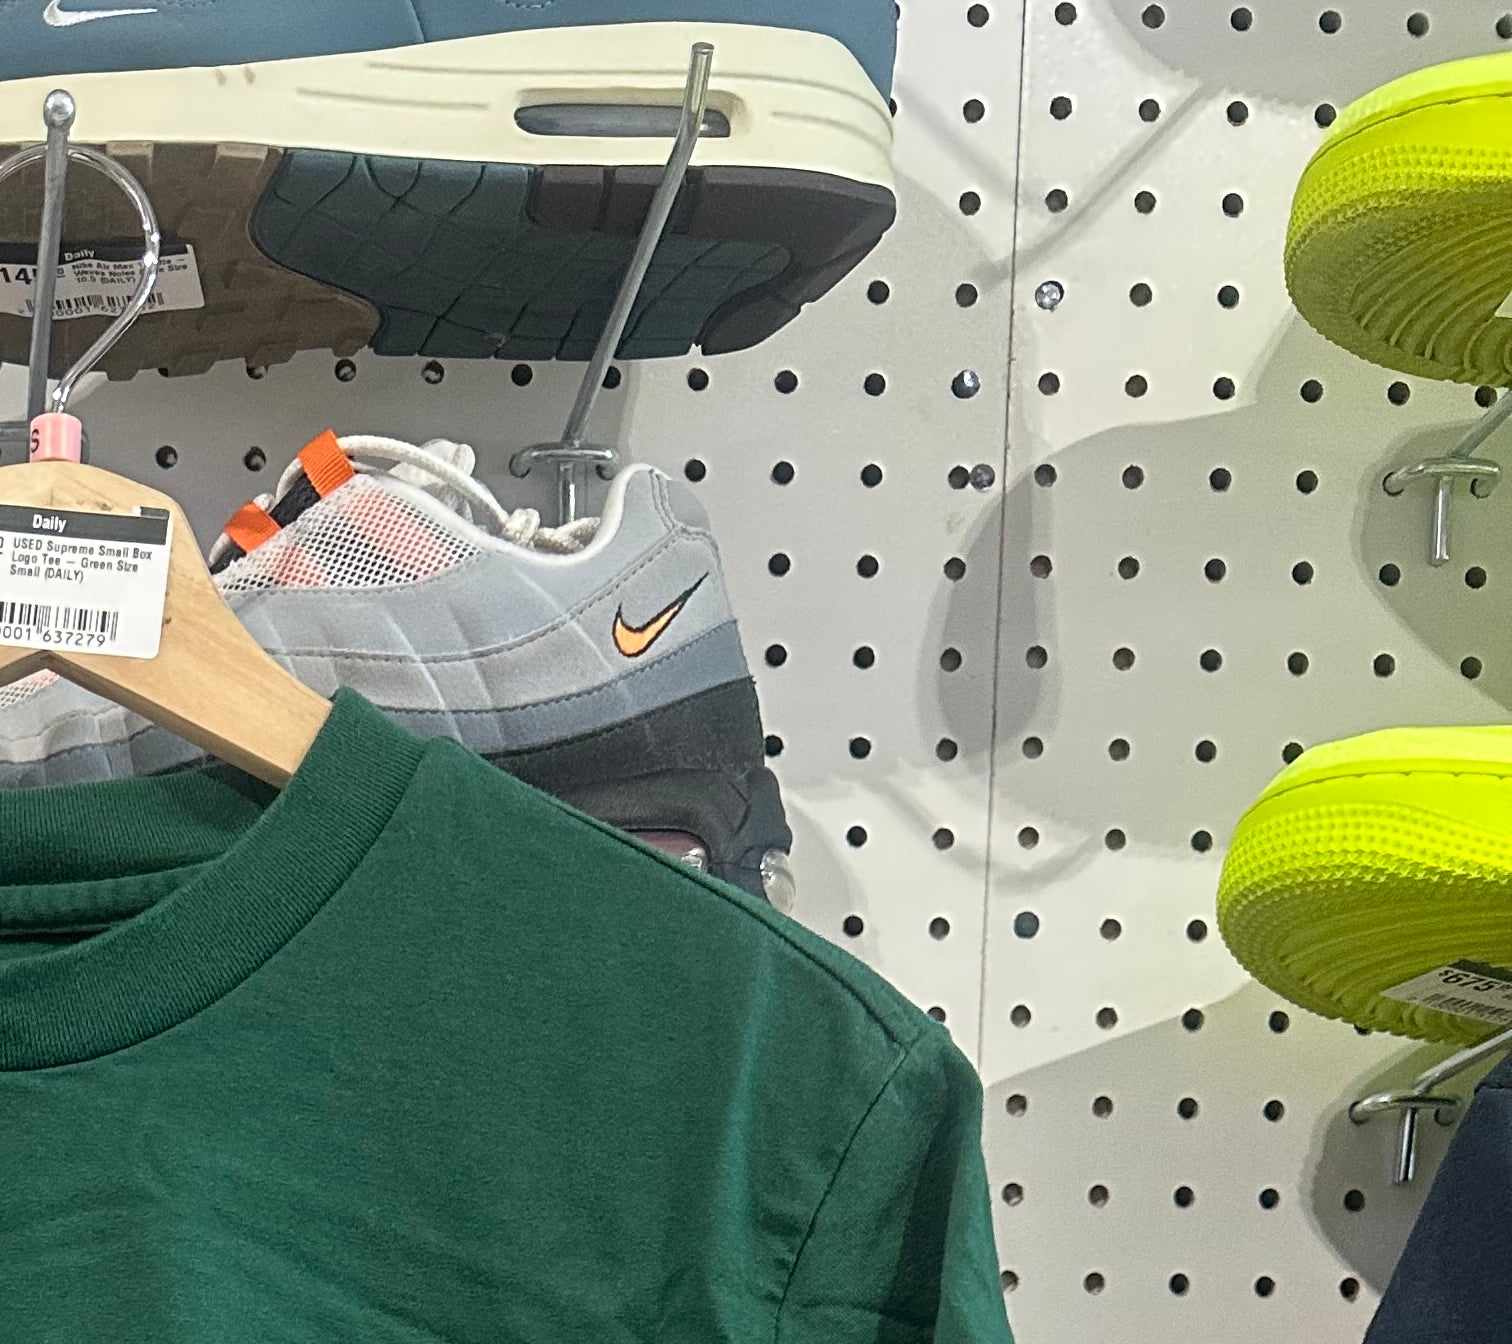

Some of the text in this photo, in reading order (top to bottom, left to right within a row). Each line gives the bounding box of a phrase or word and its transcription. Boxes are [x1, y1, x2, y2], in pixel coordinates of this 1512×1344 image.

[64, 249, 95, 261] Daily
[33, 514, 67, 533] Daily
[13, 537, 152, 560] USED Supreme Small Box
[11, 551, 38, 565] Logo
[42, 553, 61, 565] Tee
[81, 557, 113, 570] Green
[117, 560, 138, 573] Size
[10, 564, 84, 584] Small (DAILY)
[43, 629, 106, 647] 637279
[1439, 969, 1502, 992] $675
